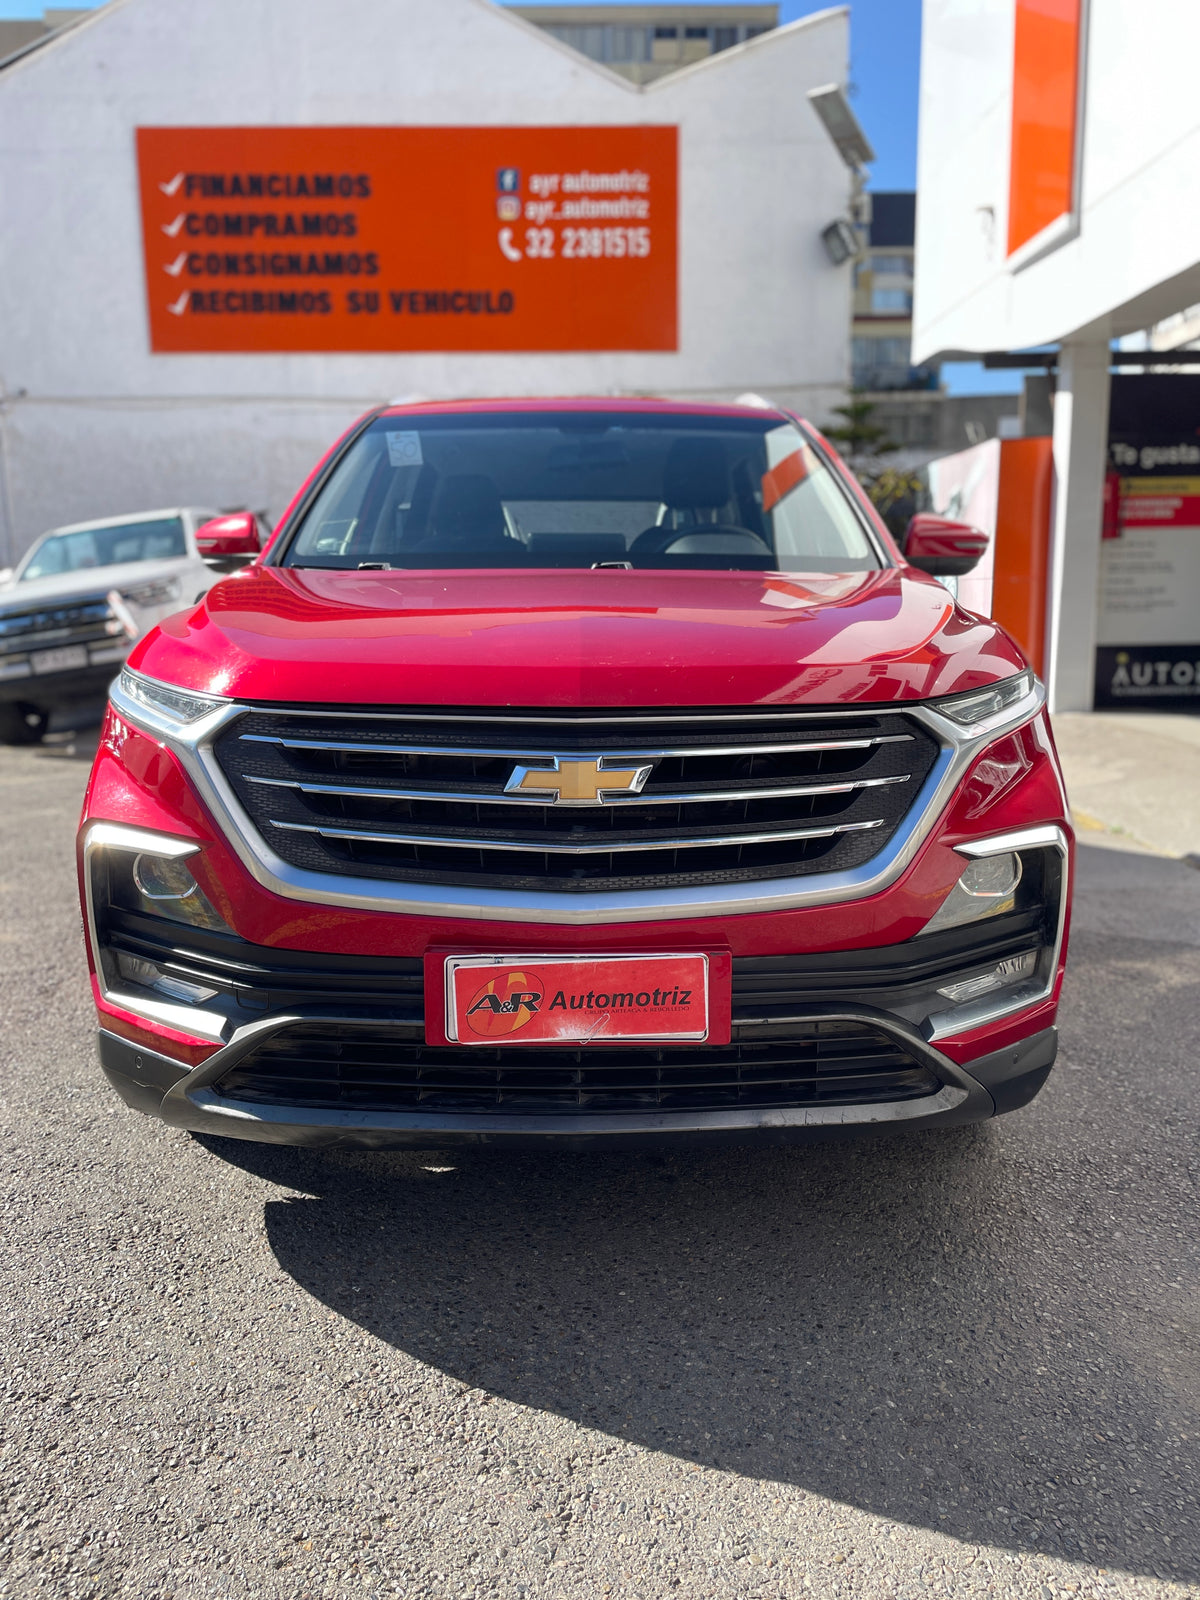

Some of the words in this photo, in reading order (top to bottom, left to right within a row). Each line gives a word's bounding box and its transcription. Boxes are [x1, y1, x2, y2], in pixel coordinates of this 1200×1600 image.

[185, 173, 371, 198] FINANCIAMOS
[529, 173, 559, 198] ayr
[561, 170, 650, 193] automotriz
[525, 196, 650, 225] ayr_automotriz
[185, 213, 357, 237] COMPRAMOS
[525, 227, 555, 259] 32
[187, 252, 380, 276] CONSIGNAMOS
[190, 289, 333, 315] RECIBIMOS
[347, 290, 380, 315] SU
[389, 289, 514, 315] VEHICULO
[1111, 442, 1138, 466] Te
[1140, 443, 1200, 470] gusta
[466, 992, 541, 1016] A&R
[548, 986, 692, 1010] Automotriz
